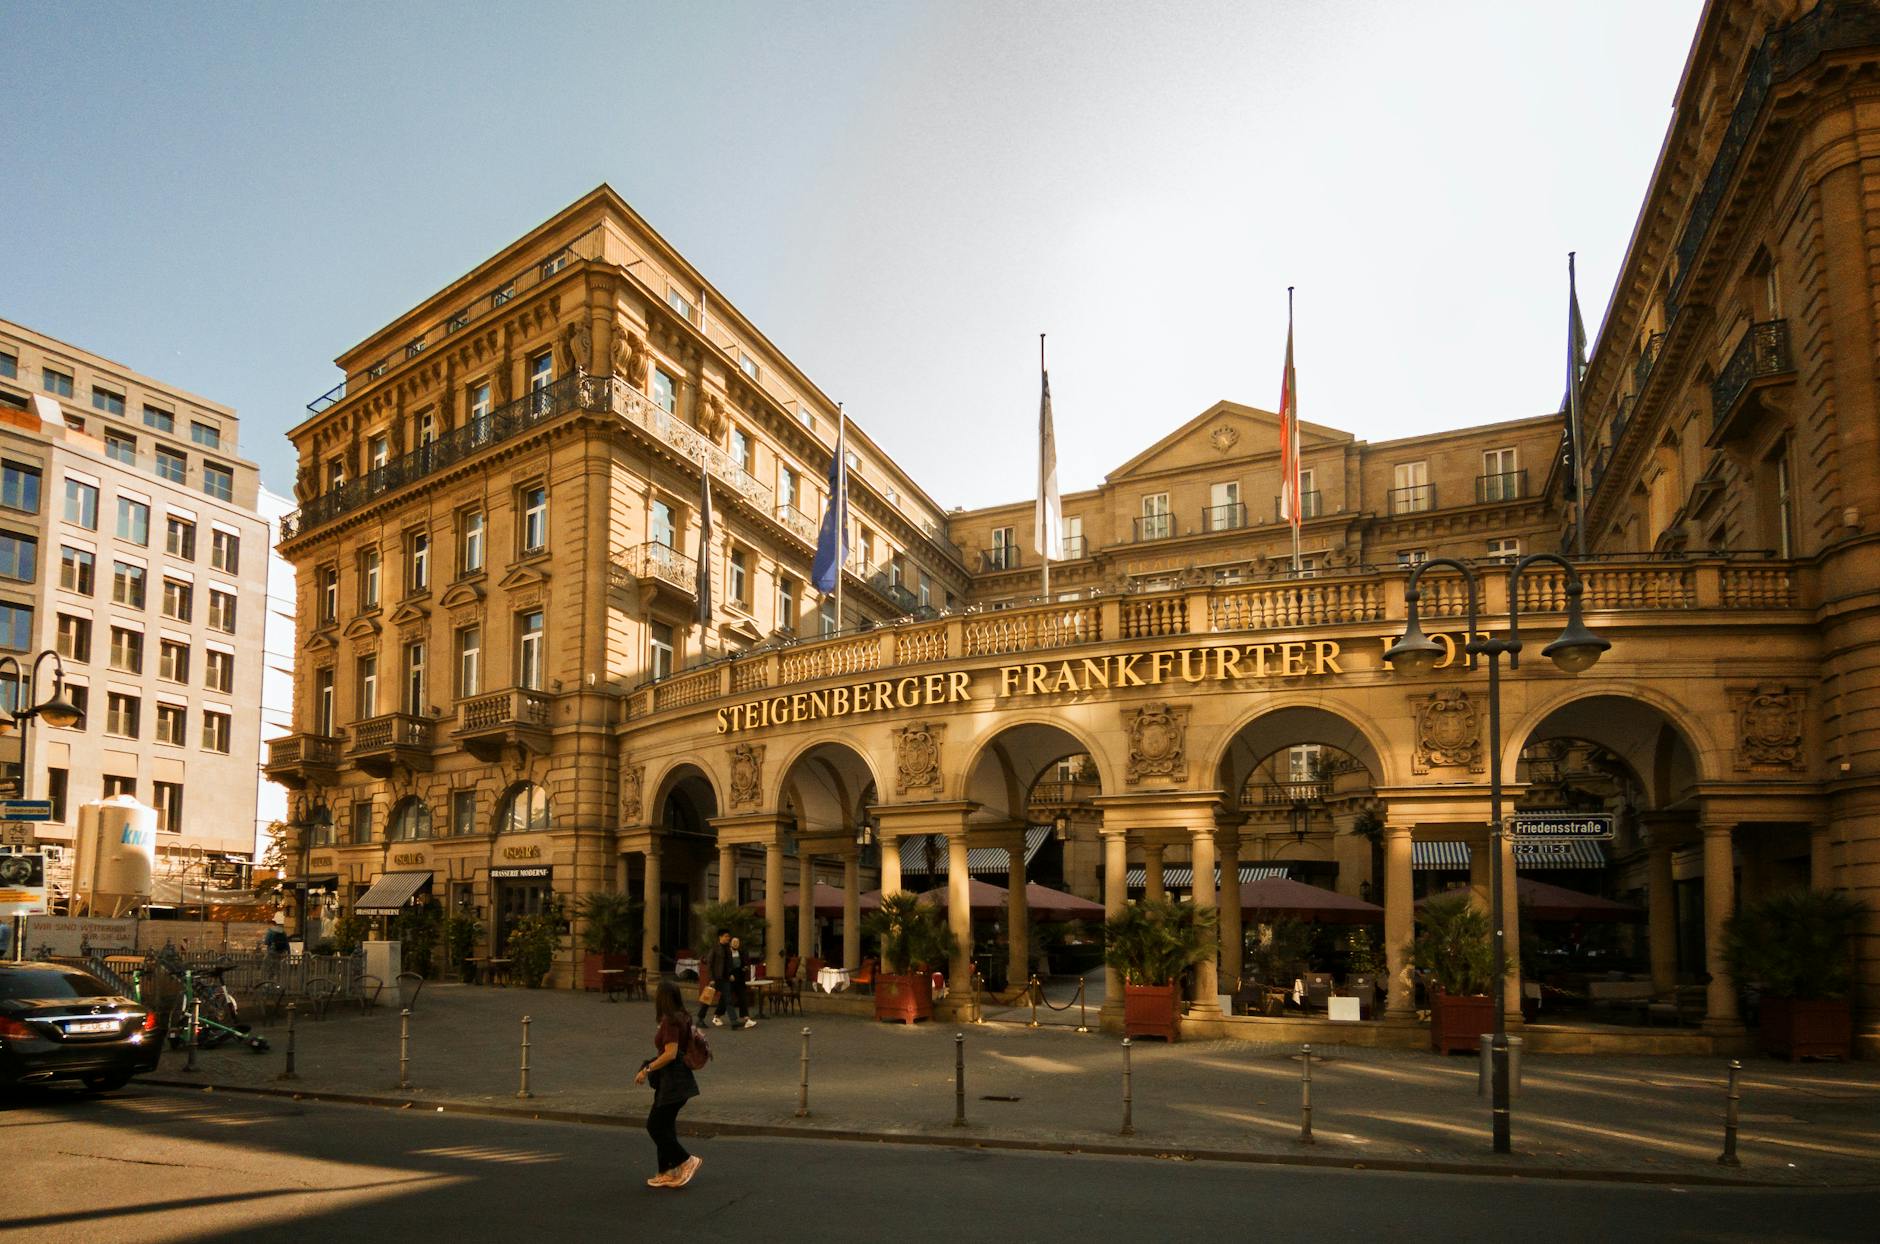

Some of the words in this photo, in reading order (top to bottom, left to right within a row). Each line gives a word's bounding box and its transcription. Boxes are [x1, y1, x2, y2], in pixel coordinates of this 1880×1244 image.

[716, 671, 972, 735] STEIGENBERGER
[999, 640, 1345, 698] FRANKFURTER
[1516, 820, 1602, 834] Friedensstraße
